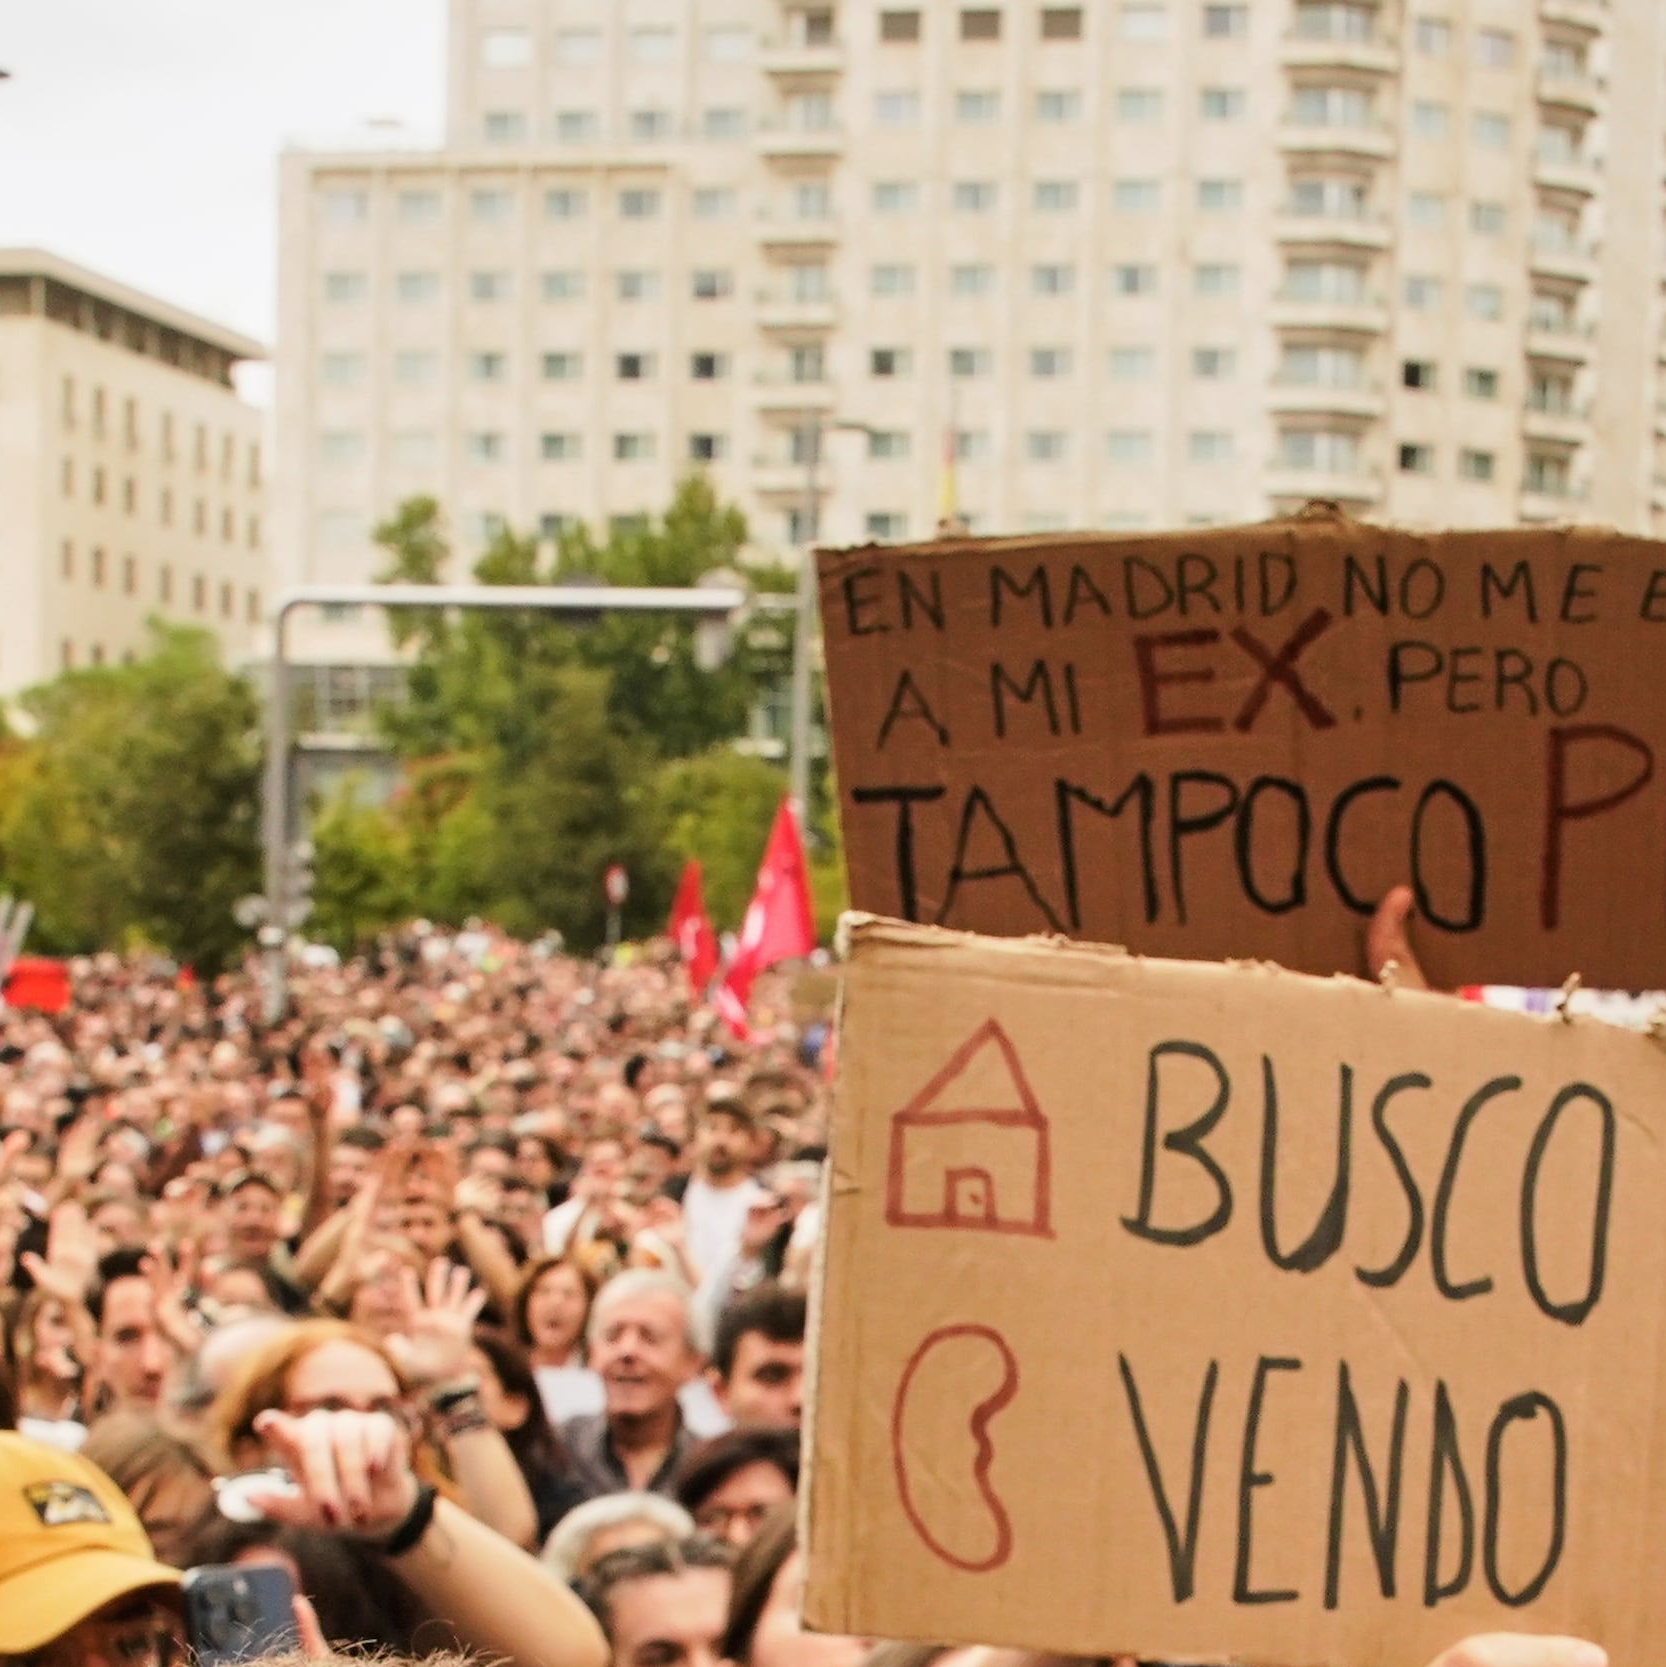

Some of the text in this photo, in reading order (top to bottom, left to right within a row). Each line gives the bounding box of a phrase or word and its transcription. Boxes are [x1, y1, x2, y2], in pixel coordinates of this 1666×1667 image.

[842, 566, 946, 636] EN
[989, 550, 1299, 629] MADRID
[1342, 554, 1444, 621] NO
[1480, 559, 1603, 624] ME
[877, 669, 951, 749] A
[988, 658, 1082, 738] MI
[1386, 640, 1588, 717] PERO
[852, 772, 1487, 934] TAMPOCO
[1119, 1038, 1616, 1327] BUSCO
[1117, 1349, 1568, 1613] VENDO
